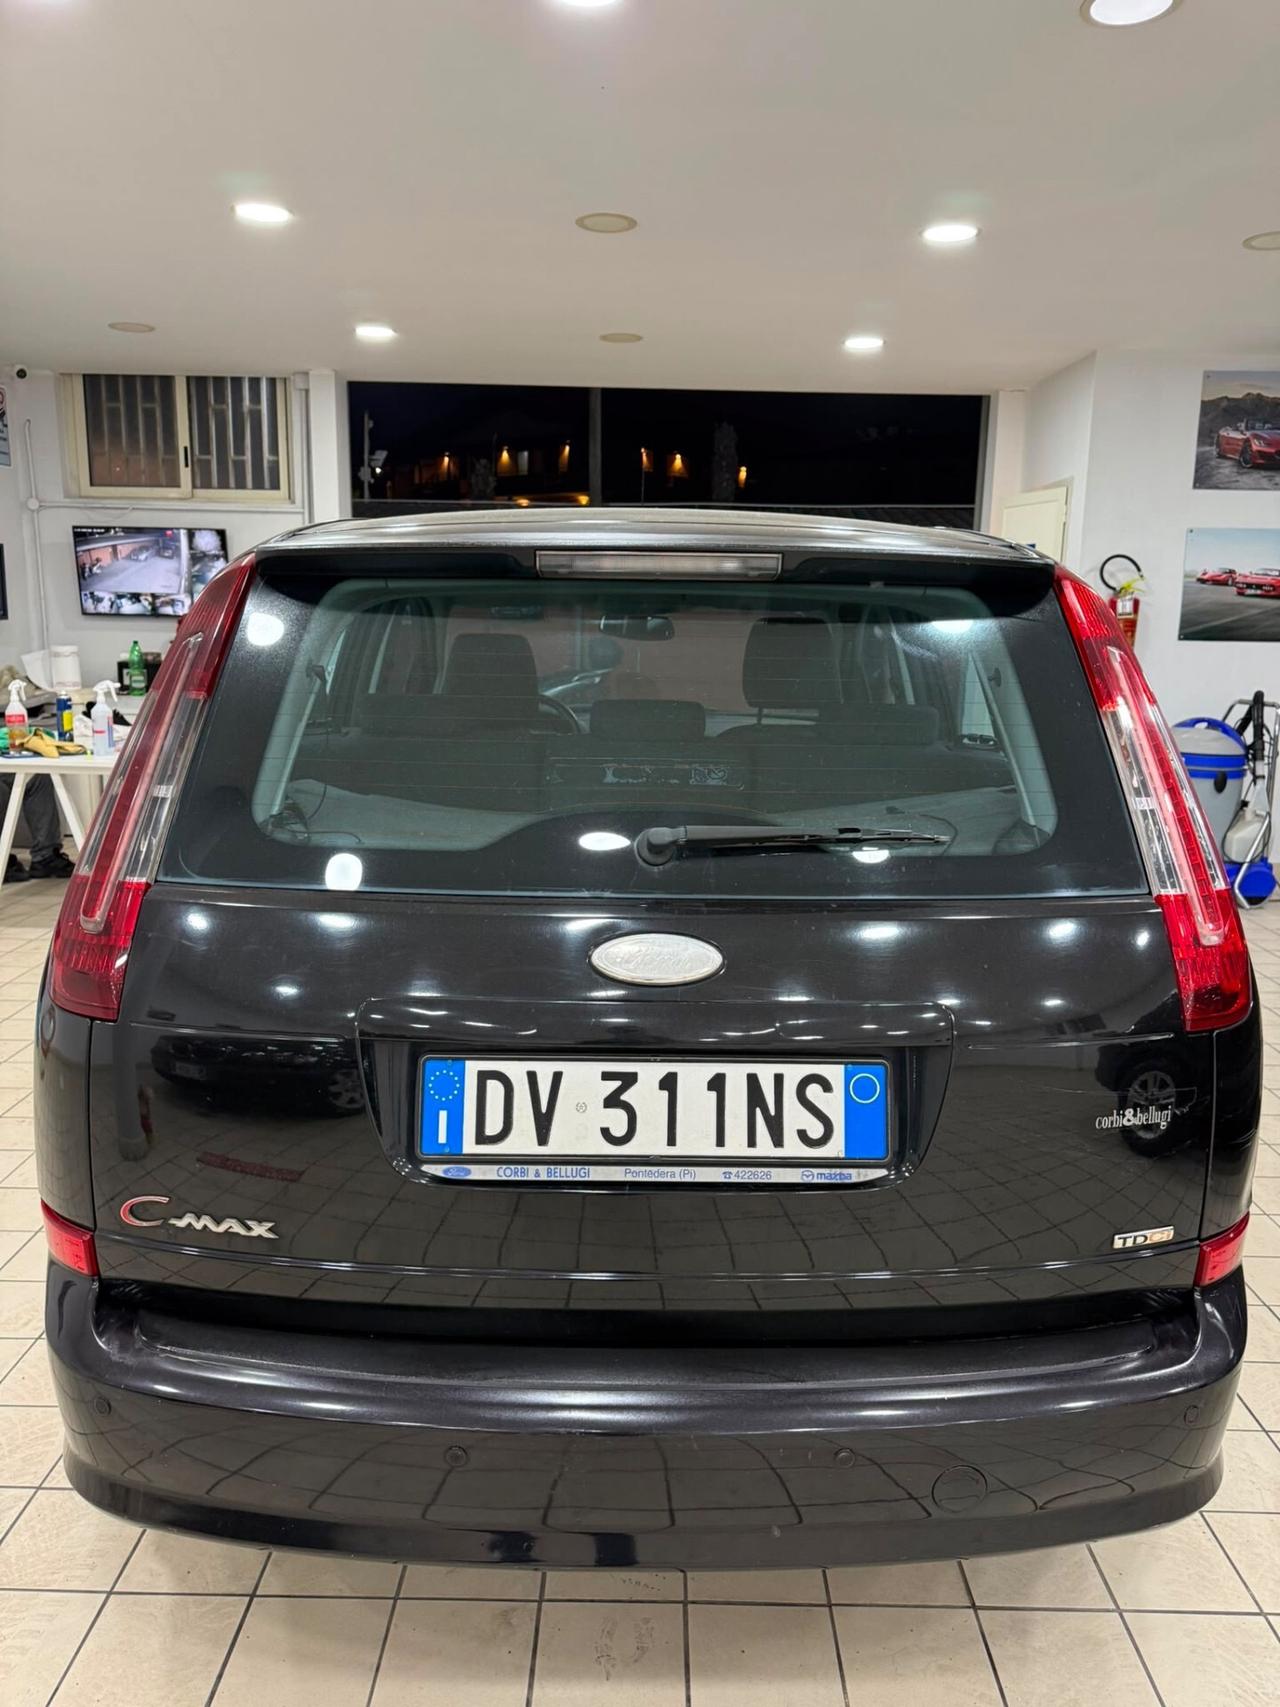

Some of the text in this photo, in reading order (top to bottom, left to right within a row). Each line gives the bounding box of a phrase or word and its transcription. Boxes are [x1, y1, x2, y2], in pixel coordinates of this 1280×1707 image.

[475, 1070, 835, 1149] DV 311NS
[496, 1167, 590, 1178] CORBI & BELLUGI
[624, 1168, 696, 1180] Pontedera (Pi)
[733, 1170, 772, 1181] 422626
